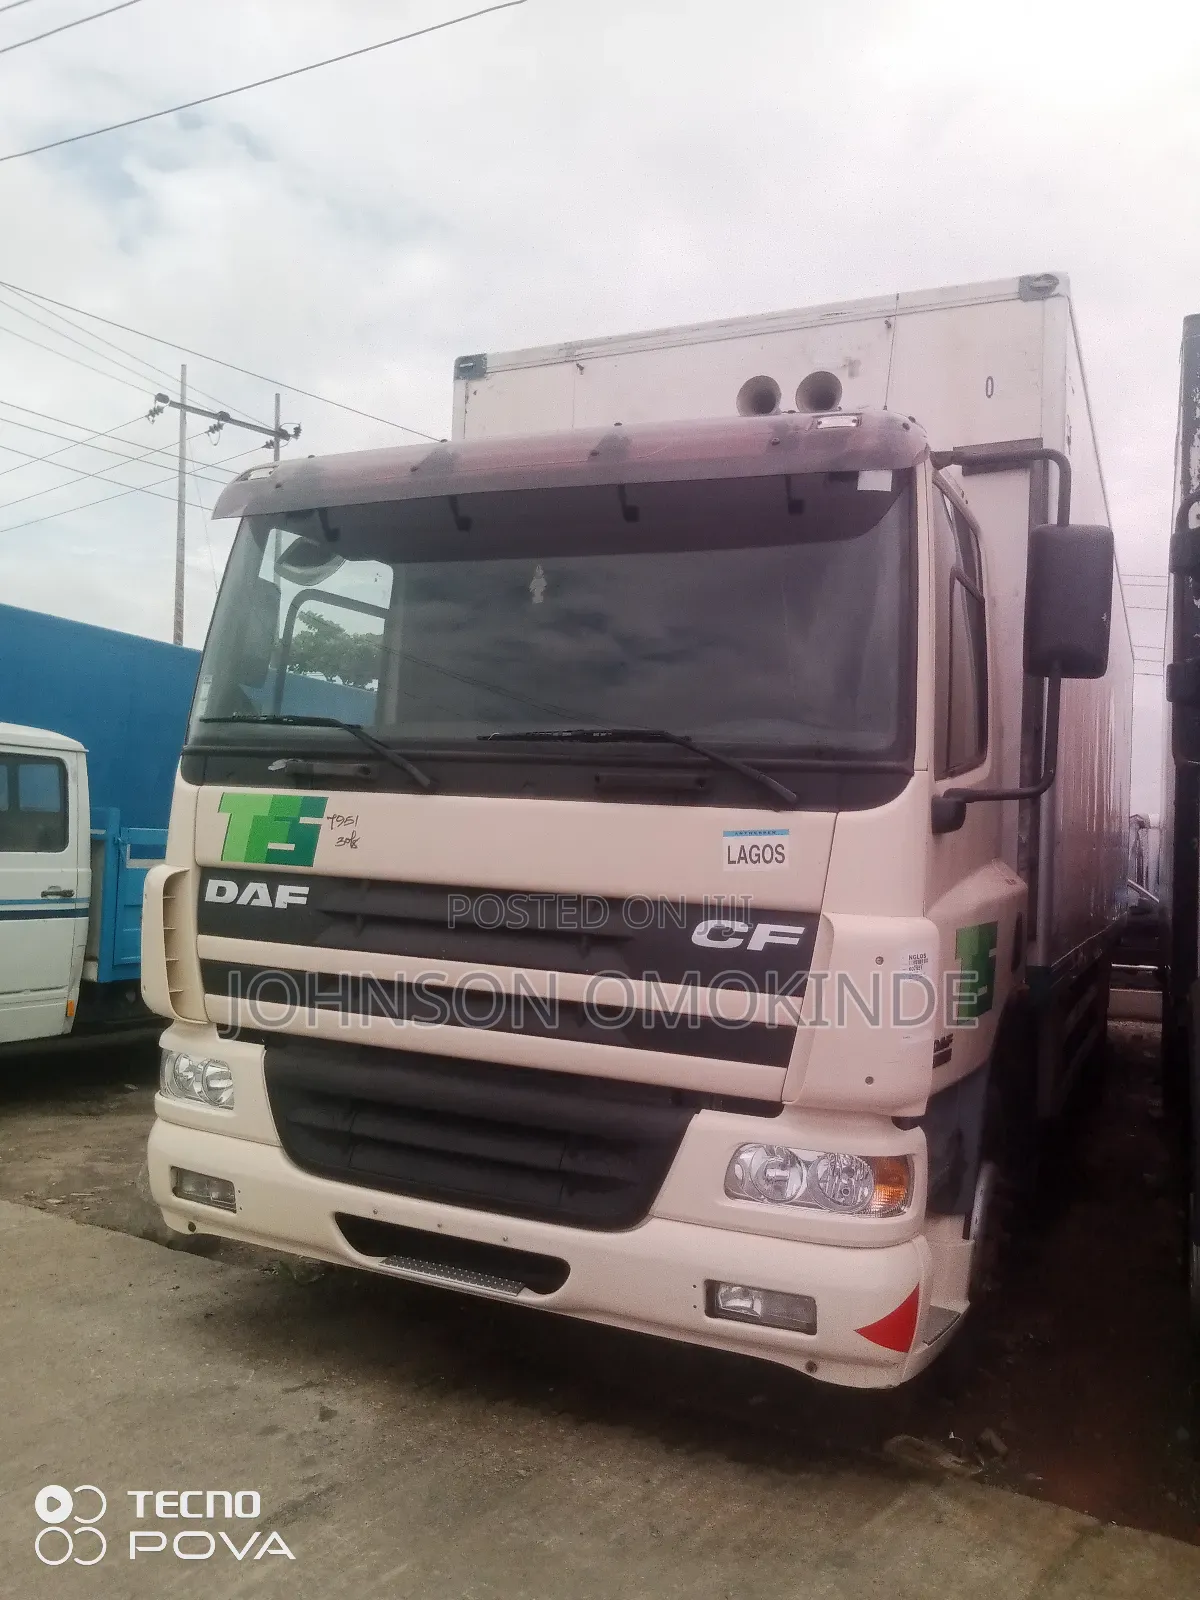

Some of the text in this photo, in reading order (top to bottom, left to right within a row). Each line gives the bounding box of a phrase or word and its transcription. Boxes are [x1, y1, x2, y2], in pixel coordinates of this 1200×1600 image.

[727, 843, 786, 865] LAGOS
[204, 878, 310, 909] DAF
[691, 919, 806, 951] CF
